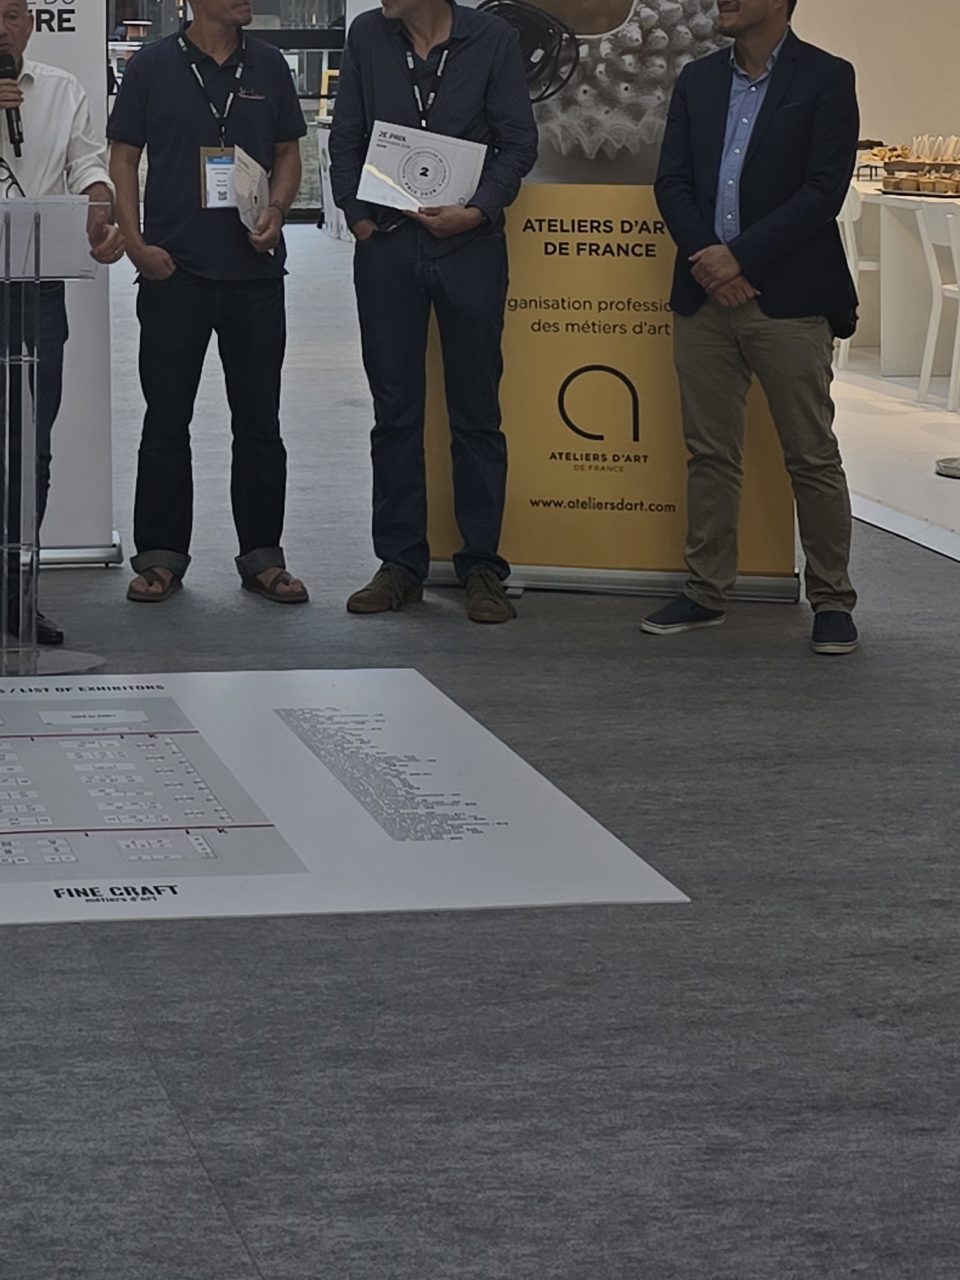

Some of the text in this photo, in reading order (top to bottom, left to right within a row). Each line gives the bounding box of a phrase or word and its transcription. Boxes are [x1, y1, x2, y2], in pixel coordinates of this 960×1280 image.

[419, 166, 430, 177] 2
[522, 219, 666, 234] ATELIERS D'AR
[544, 242, 657, 257] DE FRANCE
[506, 296, 593, 312] ganisation
[531, 319, 671, 336] des métiers d'art
[549, 452, 649, 464] ATELIERS D'ART
[573, 464, 624, 473] DE FRANCE
[529, 496, 676, 513] www.ateliersdart.com
[77, 684, 166, 692] EXHIBITORS
[53, 884, 179, 899] FINE CRAFT
